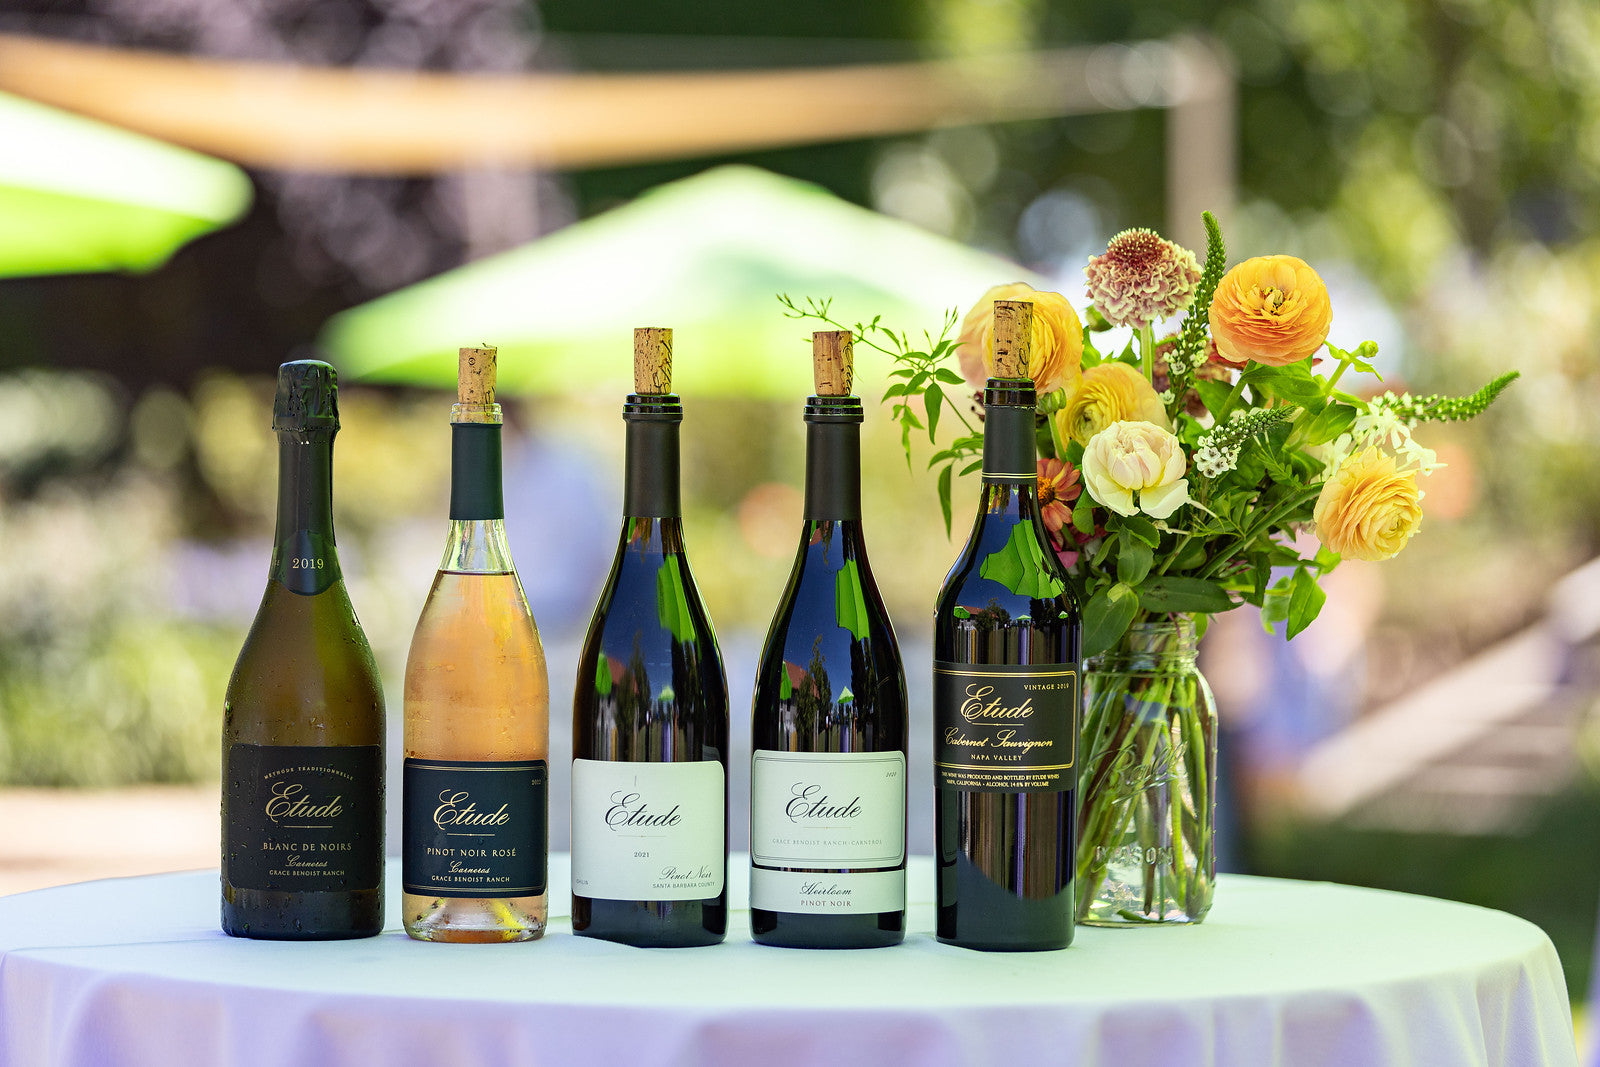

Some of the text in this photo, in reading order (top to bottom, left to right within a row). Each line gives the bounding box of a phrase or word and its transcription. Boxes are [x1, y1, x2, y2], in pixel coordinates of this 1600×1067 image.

[292, 558, 324, 569] 2019
[1023, 683, 1055, 691] VINTAGE
[960, 683, 1035, 723] Etude
[944, 727, 1053, 755] Cabernet Sauvignon
[298, 766, 354, 781] TRADITIONNELLE
[956, 779, 982, 787] CALIFORNIA
[1031, 780, 1049, 788] VOLUME
[265, 781, 343, 823] Etude
[785, 781, 863, 824] Etude
[433, 789, 511, 831] Etude
[604, 790, 682, 832] Etude
[263, 842, 352, 852] BLANC DE NOIRS
[792, 838, 820, 846] BENOIST
[427, 847, 517, 858] PINOT NOIR ROSÉ
[285, 854, 328, 868] Carneros
[448, 860, 491, 874] Carneros
[659, 864, 712, 880] Pinot Noir
[800, 881, 852, 896] Heirloom
